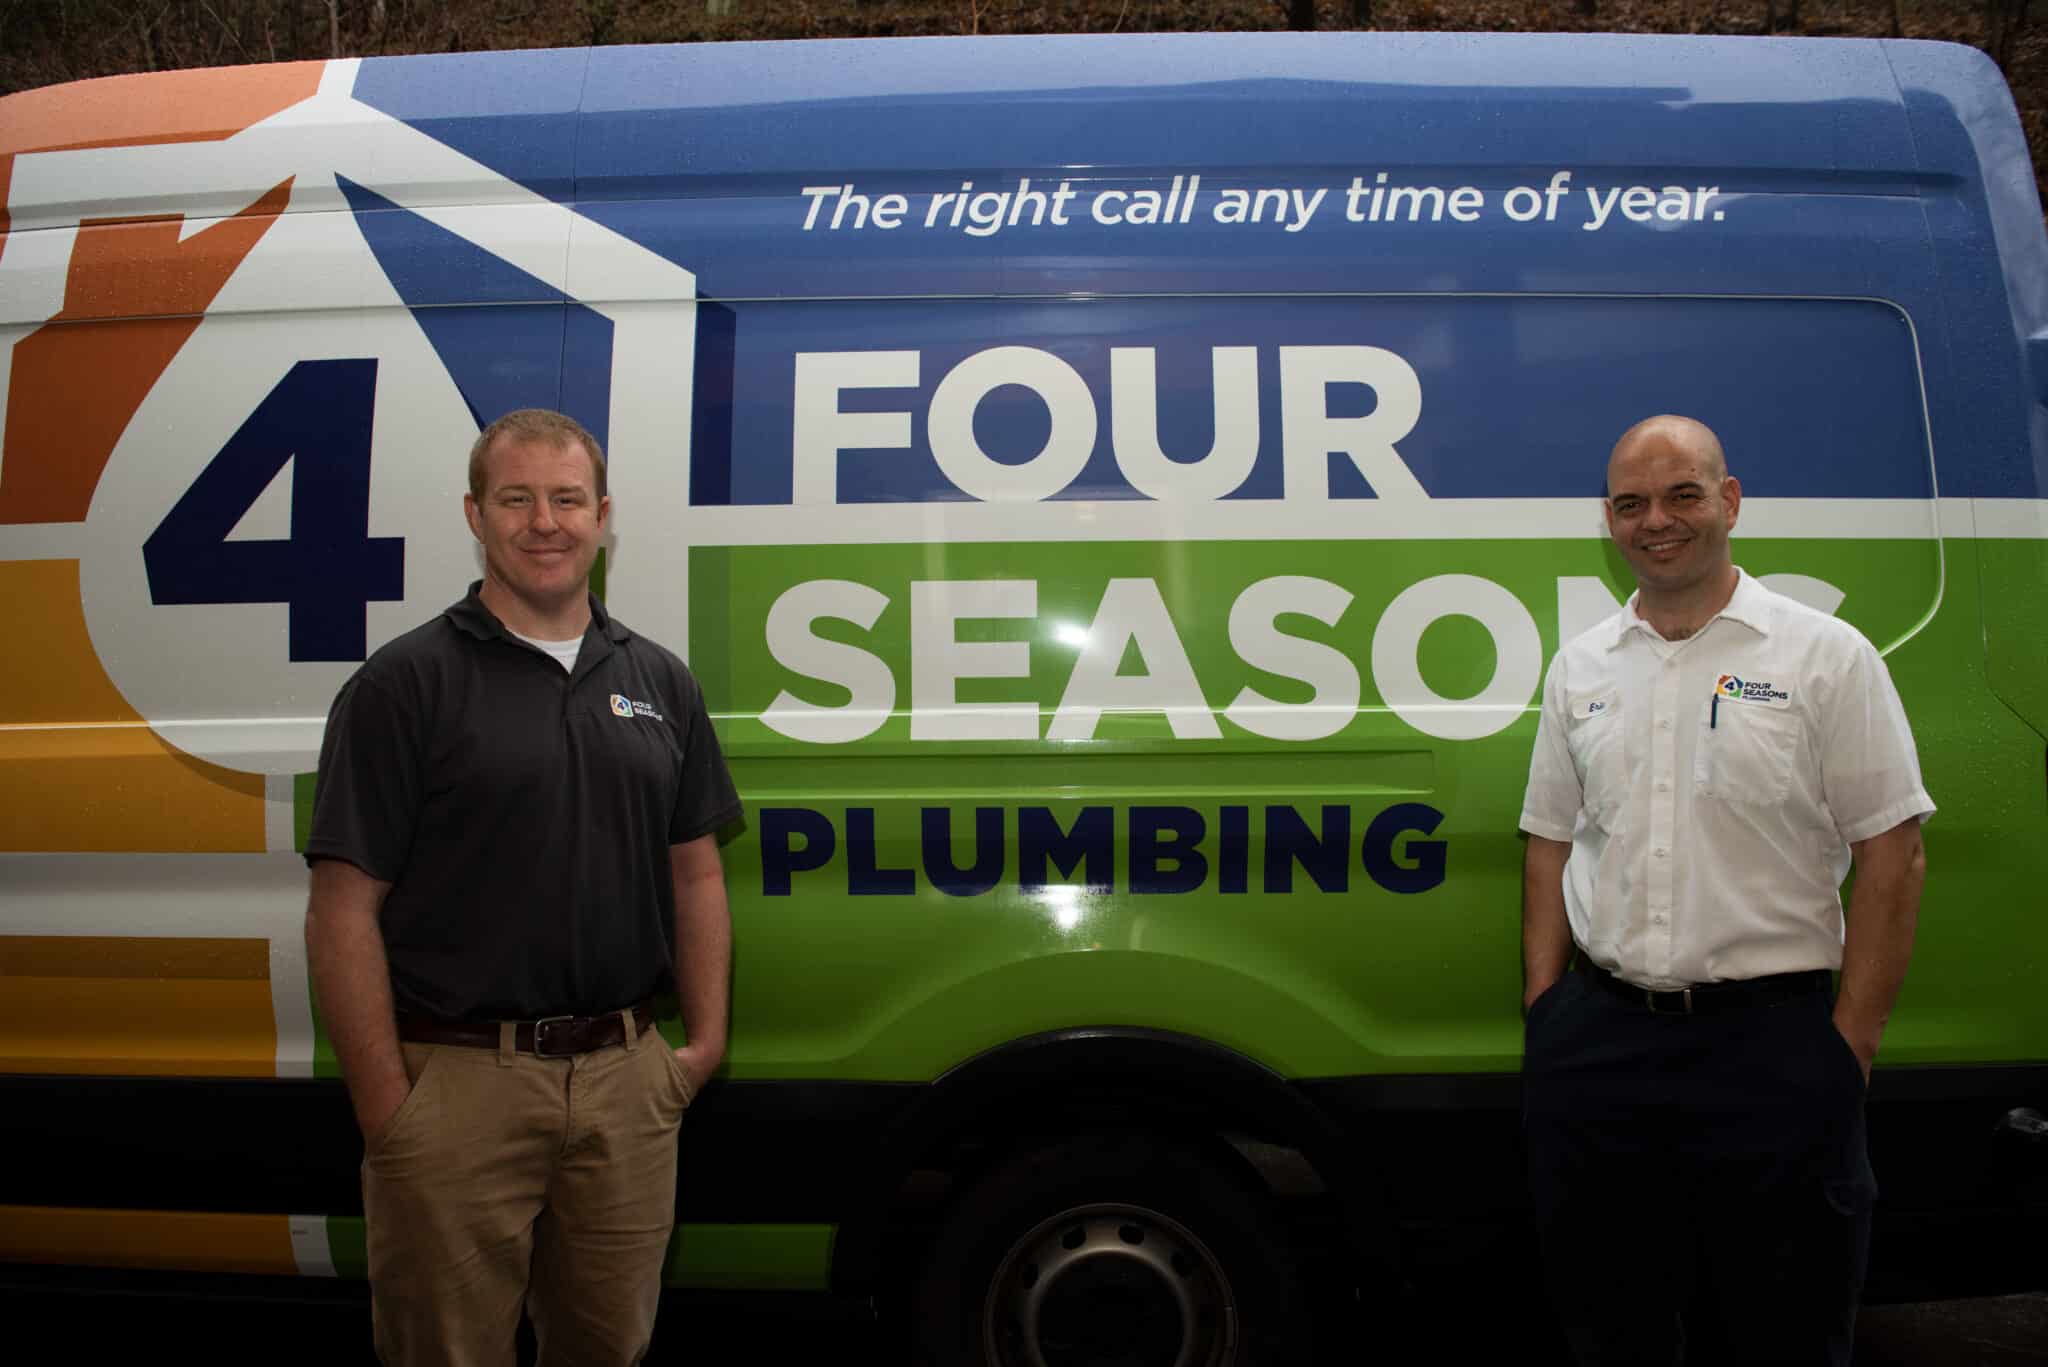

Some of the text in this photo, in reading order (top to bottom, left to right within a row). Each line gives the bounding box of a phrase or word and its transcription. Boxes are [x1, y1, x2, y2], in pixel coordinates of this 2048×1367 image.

[801, 171, 1725, 237] The right call any time of year.
[792, 345, 1430, 504] FOUR
[142, 358, 404, 661] 4
[758, 573, 1846, 744] SEASO
[1743, 688, 1788, 700] SEASONS
[1744, 682, 1771, 691] FOUR
[760, 803, 1447, 896] PLUMBING
